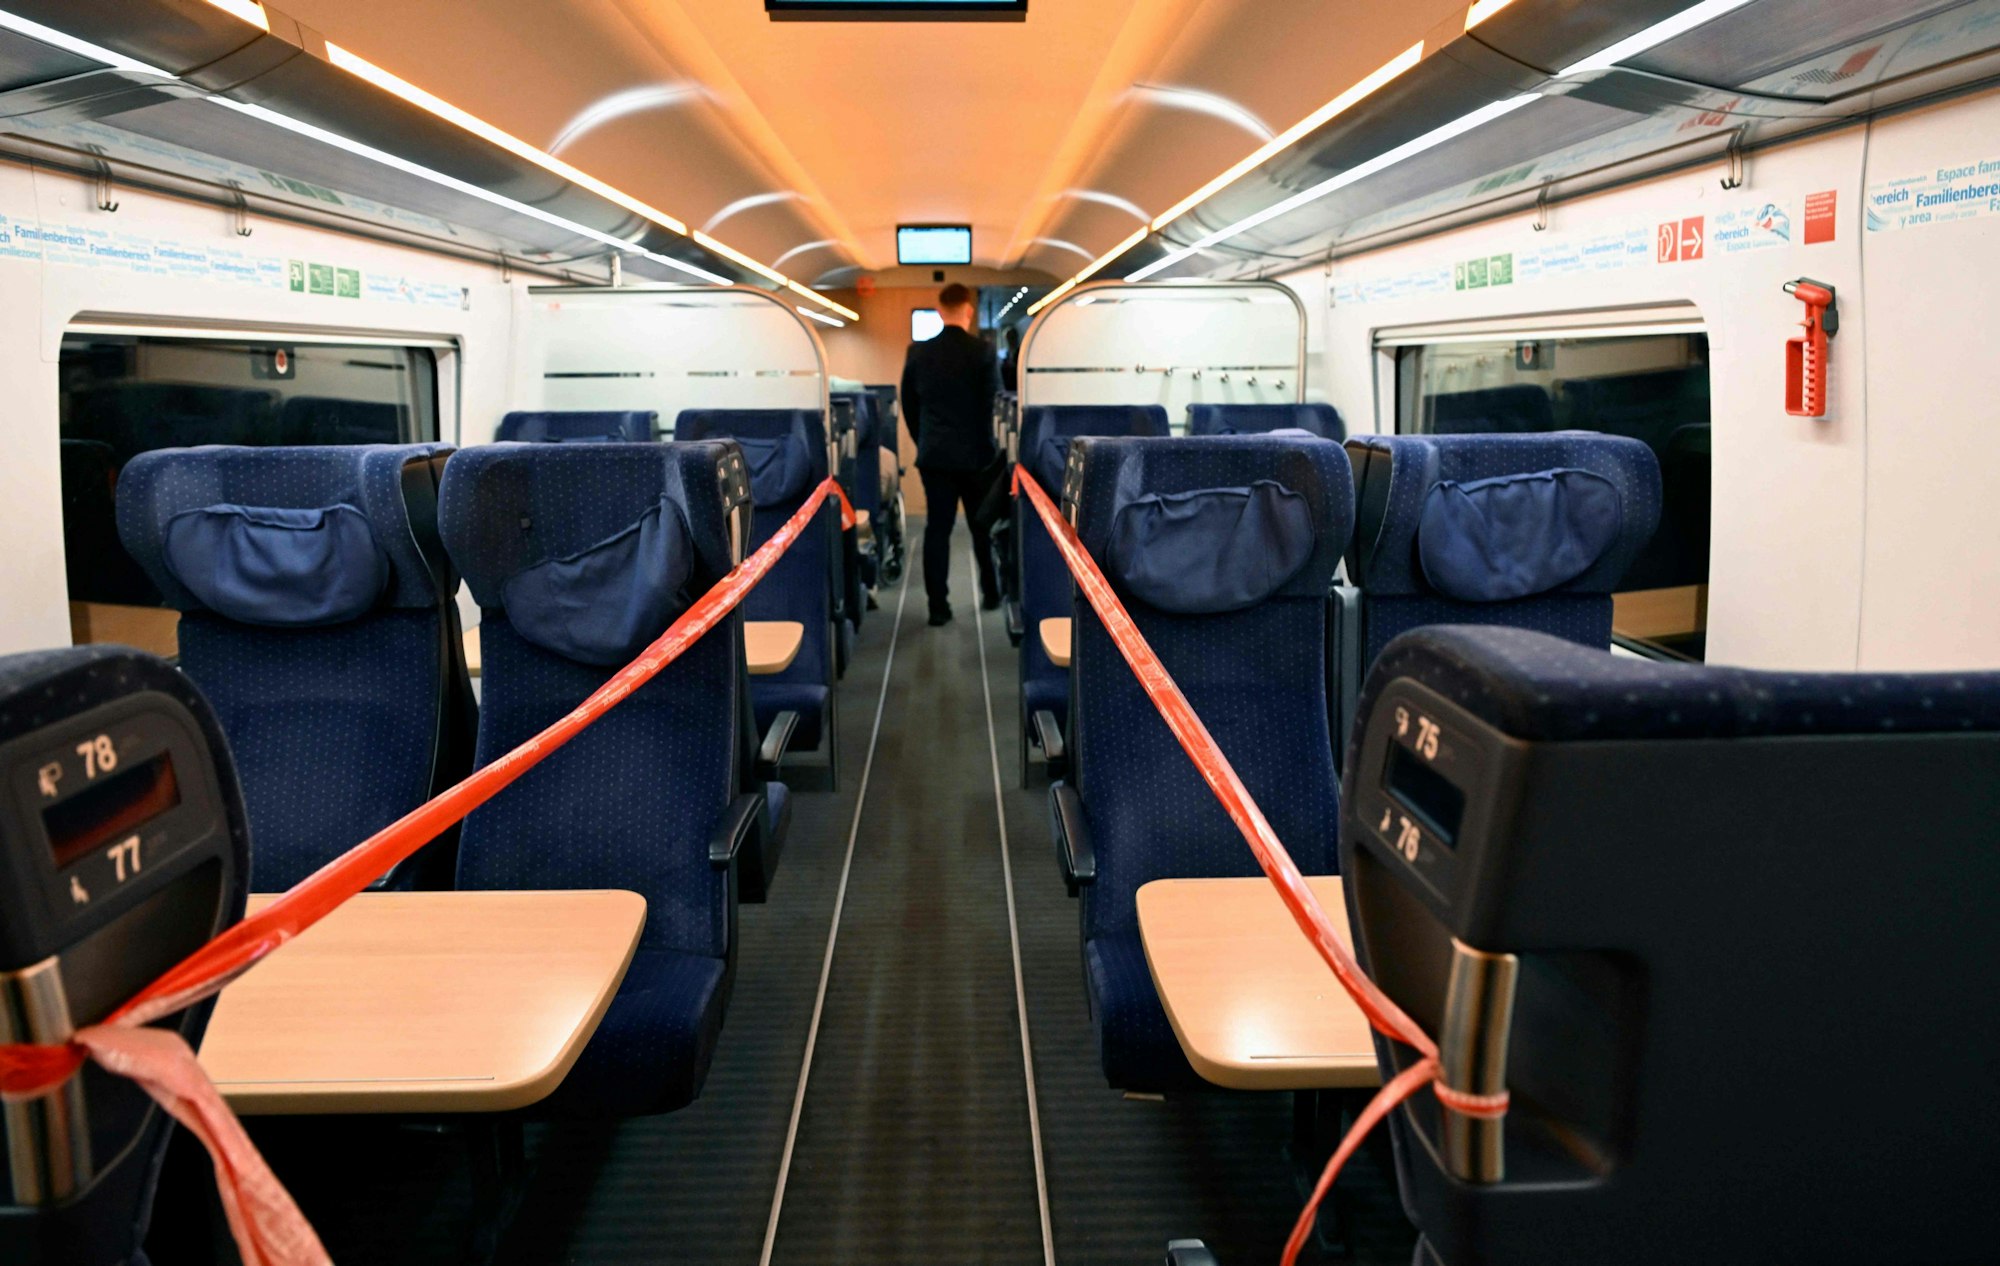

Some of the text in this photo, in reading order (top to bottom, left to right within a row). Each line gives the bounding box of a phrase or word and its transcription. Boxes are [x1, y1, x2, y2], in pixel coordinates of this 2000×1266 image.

[1871, 187, 1909, 206] ereich
[1936, 165, 1976, 183] Espace
[14, 224, 86, 246] Familienbereich
[76, 734, 119, 780] 78
[1416, 715, 1441, 761] 75
[107, 834, 142, 883] 77
[1396, 815, 1421, 862] 76
